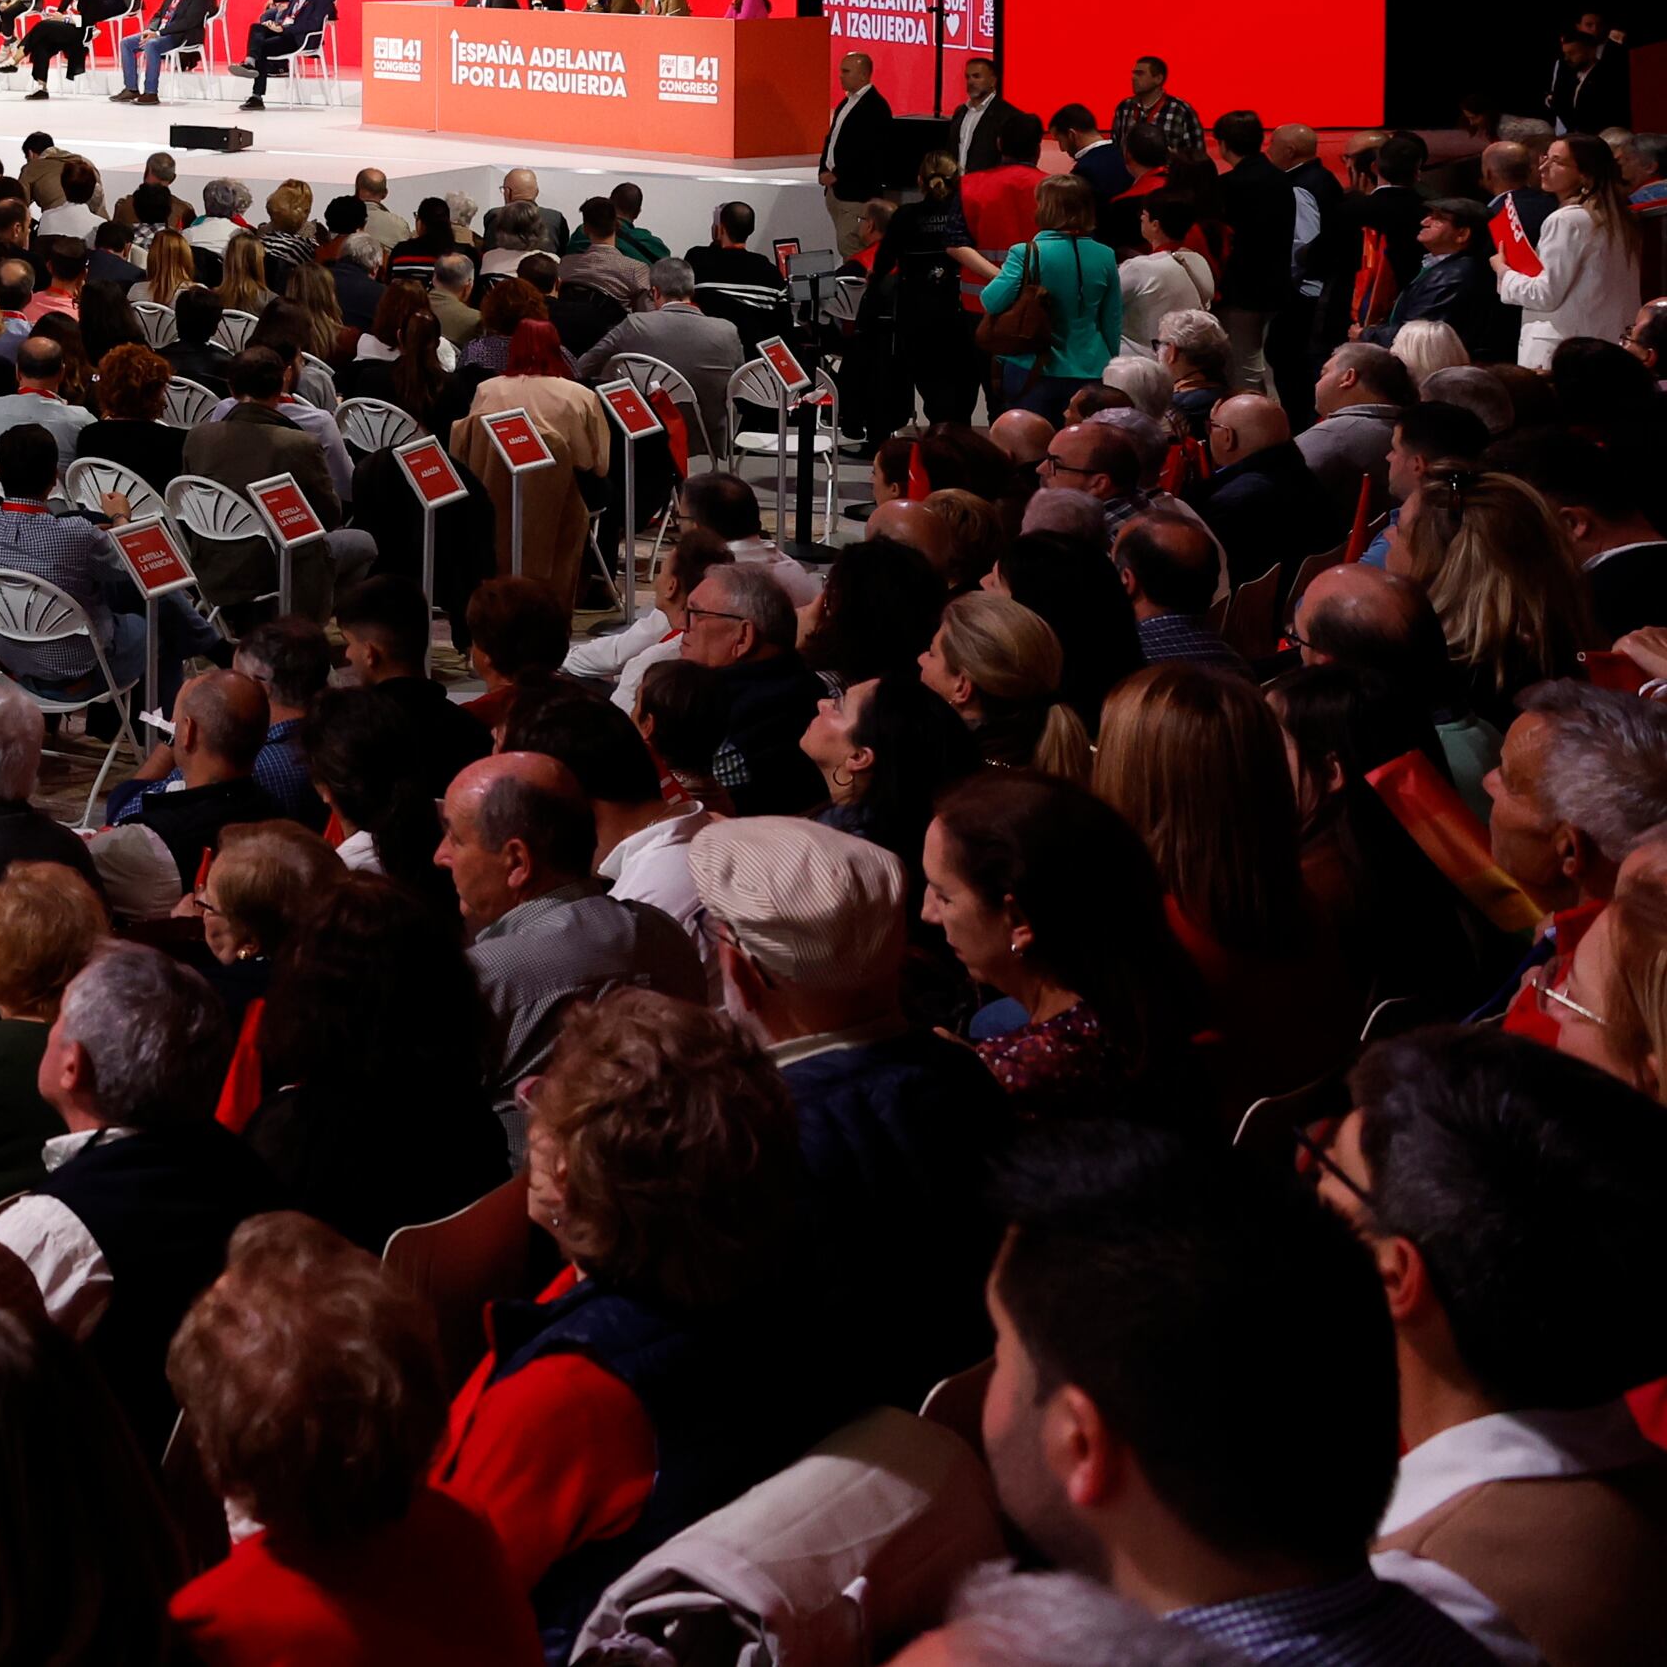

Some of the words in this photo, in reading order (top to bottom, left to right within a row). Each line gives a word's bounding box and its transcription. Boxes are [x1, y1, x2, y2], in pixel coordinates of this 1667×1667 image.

[846, 12, 928, 45] IZQUIERDA
[403, 39, 422, 62] 41
[458, 40, 525, 67] ESPAÑA
[529, 46, 627, 74] ADELANTA
[374, 60, 421, 74] CONGRESO
[695, 57, 718, 82] 41
[458, 65, 495, 88] POR
[499, 69, 522, 90] LA
[527, 70, 628, 98] IZQUIERDA
[659, 80, 718, 95] CONGRESO
